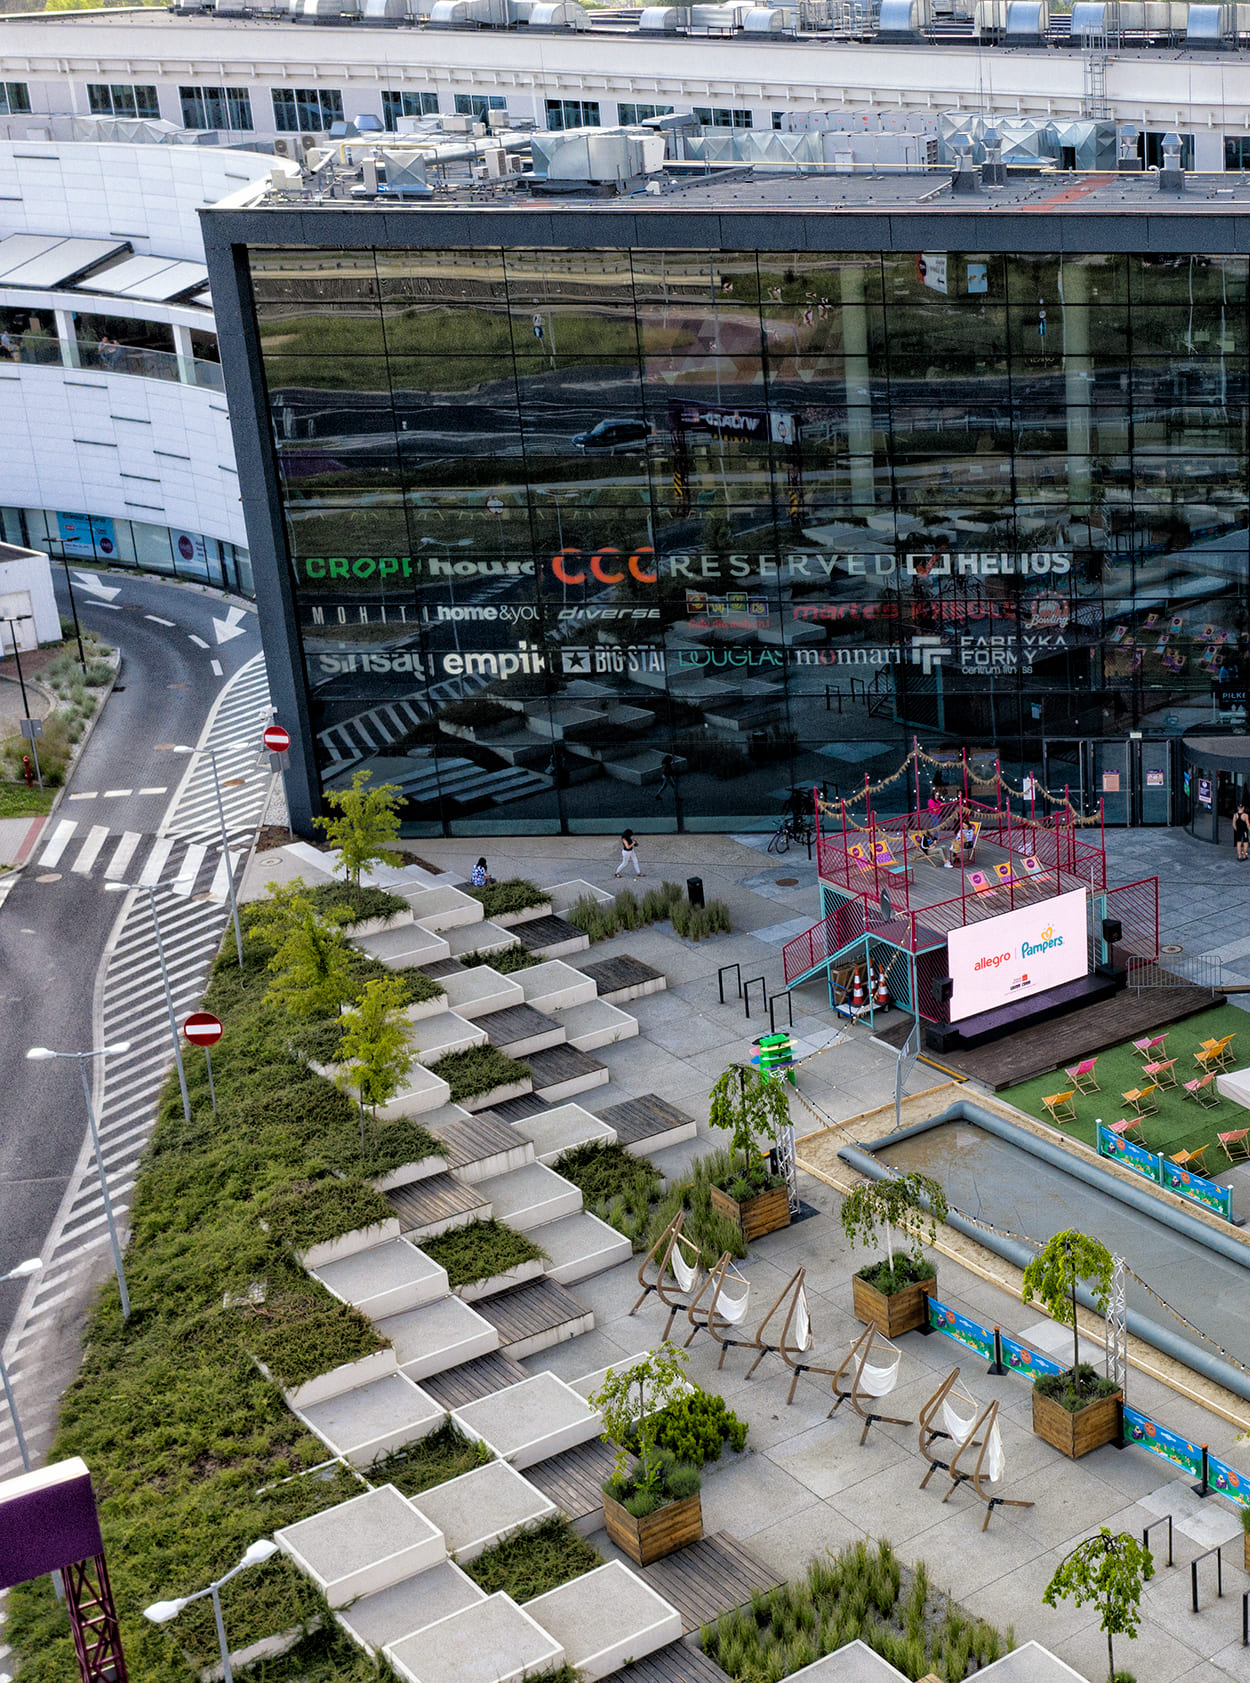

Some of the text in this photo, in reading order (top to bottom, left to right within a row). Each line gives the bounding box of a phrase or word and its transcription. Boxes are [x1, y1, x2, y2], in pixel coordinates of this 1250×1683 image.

[552, 547, 658, 585] CCC
[670, 554, 897, 578] RESERVED
[958, 553, 1071, 575] HELIOS
[558, 606, 661, 620] diverse
[793, 602, 899, 620] martes
[1024, 612, 1070, 629] Bowling
[678, 646, 784, 666] DOUGLAS
[795, 647, 901, 665] monnari
[962, 665, 1001, 674] centrum
[974, 935, 1064, 972] allegro Pampers
